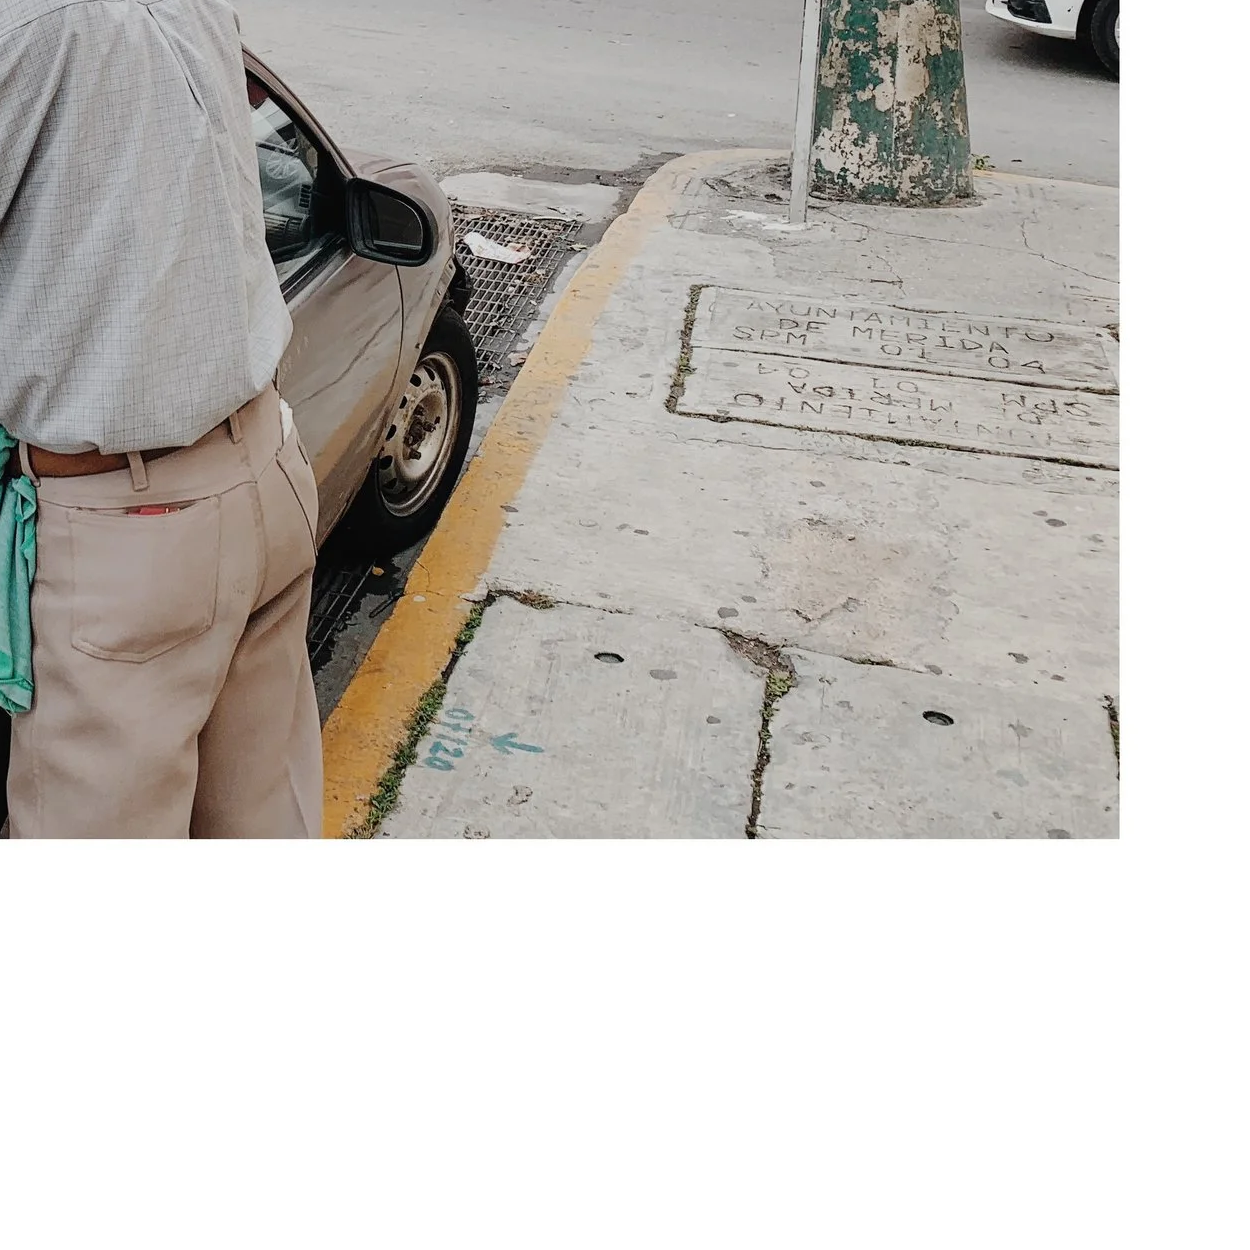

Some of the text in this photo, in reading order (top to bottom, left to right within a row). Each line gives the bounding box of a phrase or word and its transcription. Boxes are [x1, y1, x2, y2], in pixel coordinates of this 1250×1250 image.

[732, 325, 809, 346] SPM
[747, 301, 1055, 343] AYUNTAMIENTO
[778, 318, 1010, 355] DE MERIDA
[787, 381, 953, 412] MERIDA
